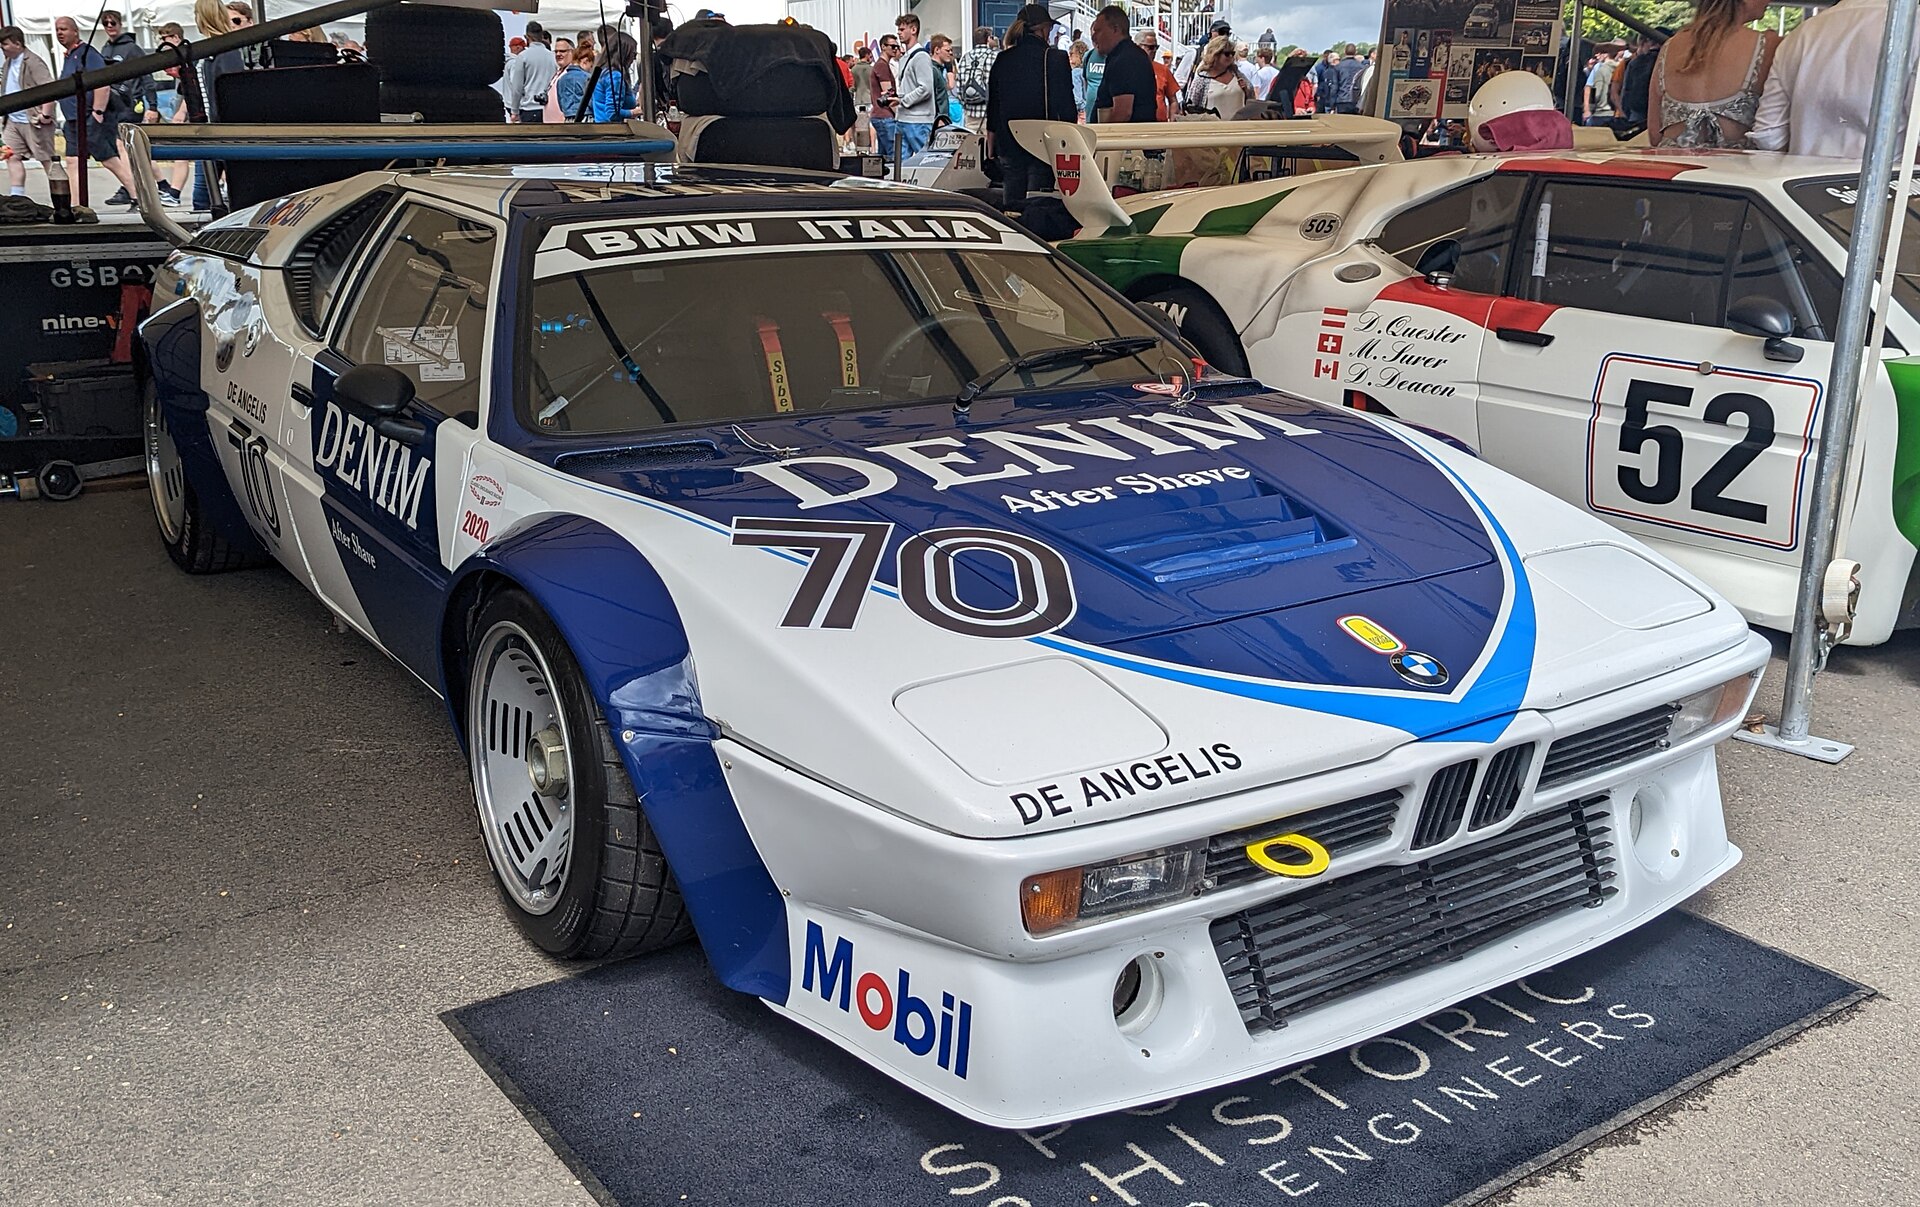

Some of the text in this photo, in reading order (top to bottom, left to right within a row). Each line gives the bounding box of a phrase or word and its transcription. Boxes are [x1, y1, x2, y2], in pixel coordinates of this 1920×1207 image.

[257, 196, 324, 227] Mobil
[583, 219, 992, 255] BMW ITALIA
[1304, 218, 1337, 234] 505
[227, 380, 268, 425] DE ANGELIS
[226, 415, 281, 539] 70
[316, 400, 432, 531] DENIM
[733, 404, 1323, 509] DENIM
[1000, 464, 1252, 514] After Shave
[1617, 378, 1776, 525] 52
[331, 518, 377, 569] After Shave
[462, 510, 490, 544] 2020
[729, 516, 1078, 639] 70
[1009, 743, 1242, 826] DE ANGELIS
[802, 919, 972, 1081] Mobil
[1258, 1003, 1656, 1197] ENGINEERS
